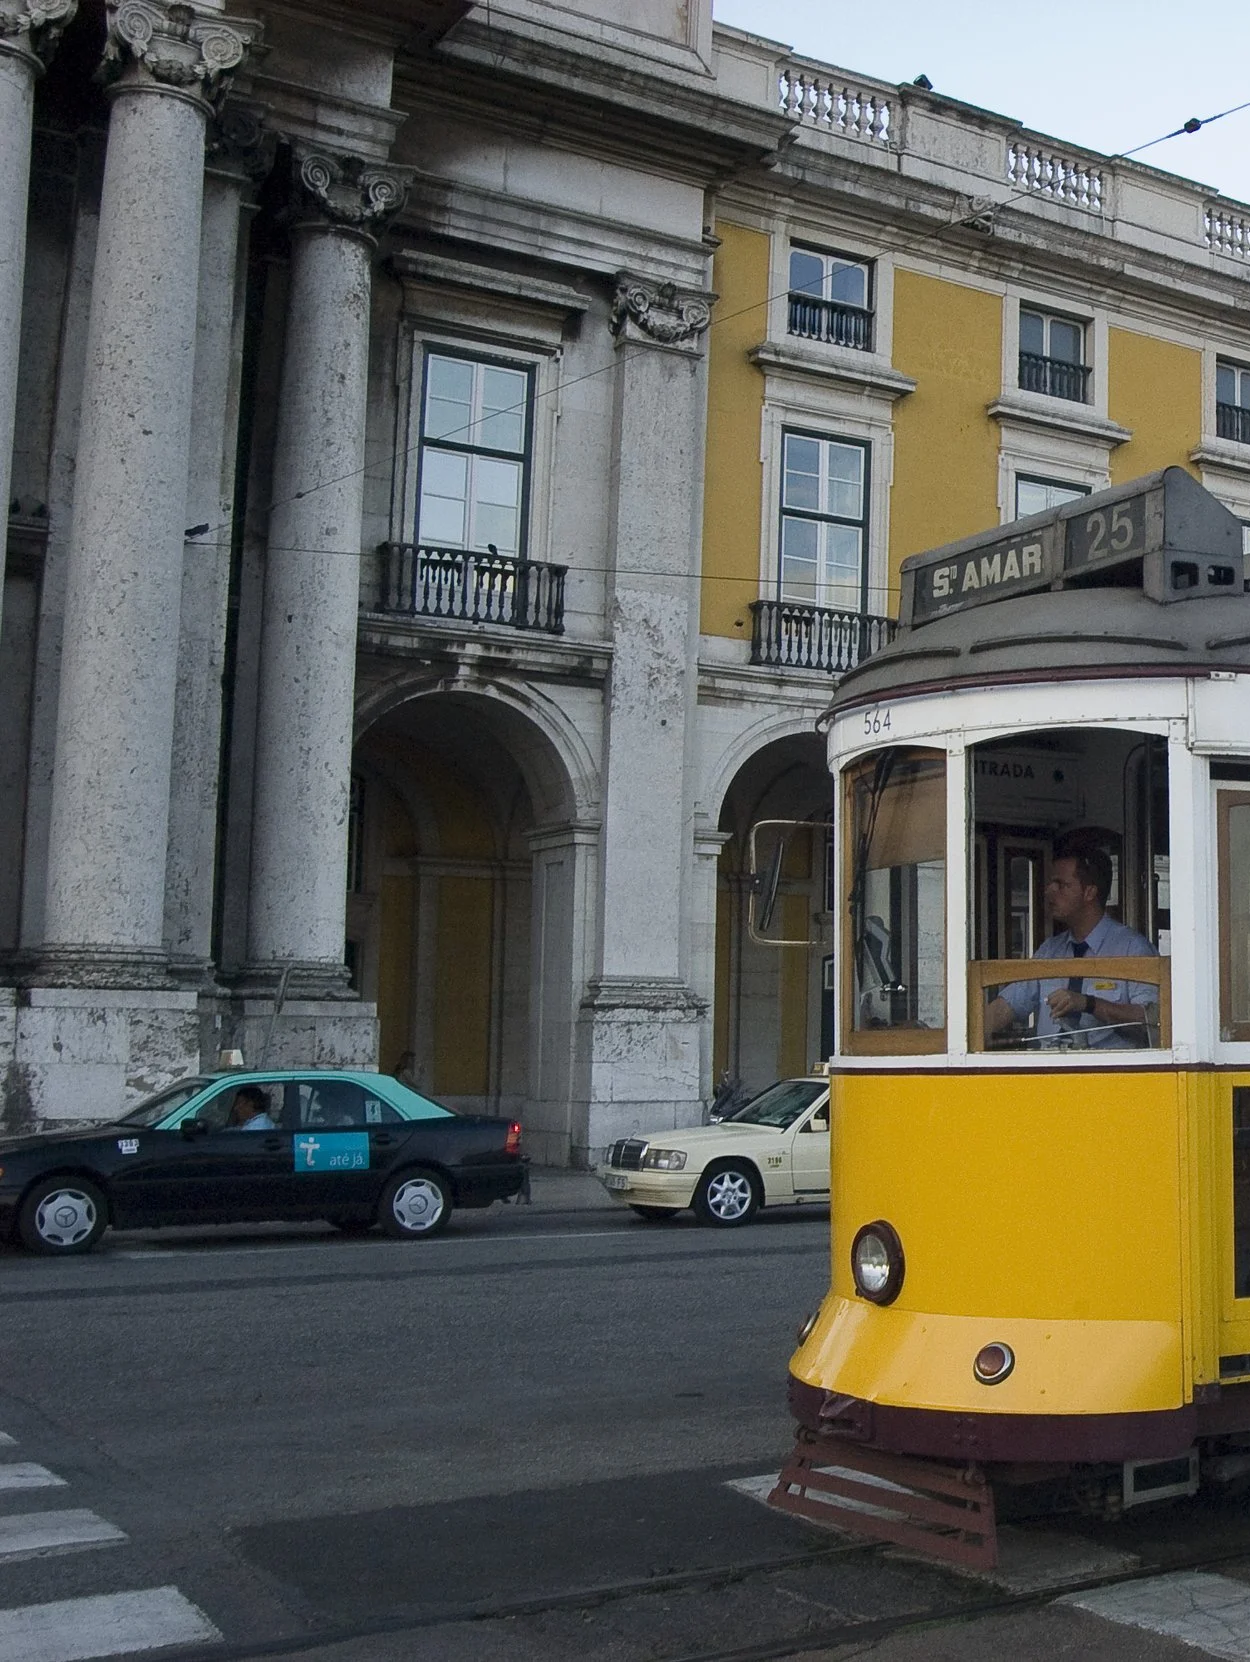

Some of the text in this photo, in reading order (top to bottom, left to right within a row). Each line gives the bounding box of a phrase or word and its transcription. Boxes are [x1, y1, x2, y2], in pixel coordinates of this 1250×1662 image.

[1086, 501, 1133, 562] 25
[961, 543, 1043, 593] AMAR
[864, 709, 892, 735] 564
[329, 1153, 350, 1166] até
